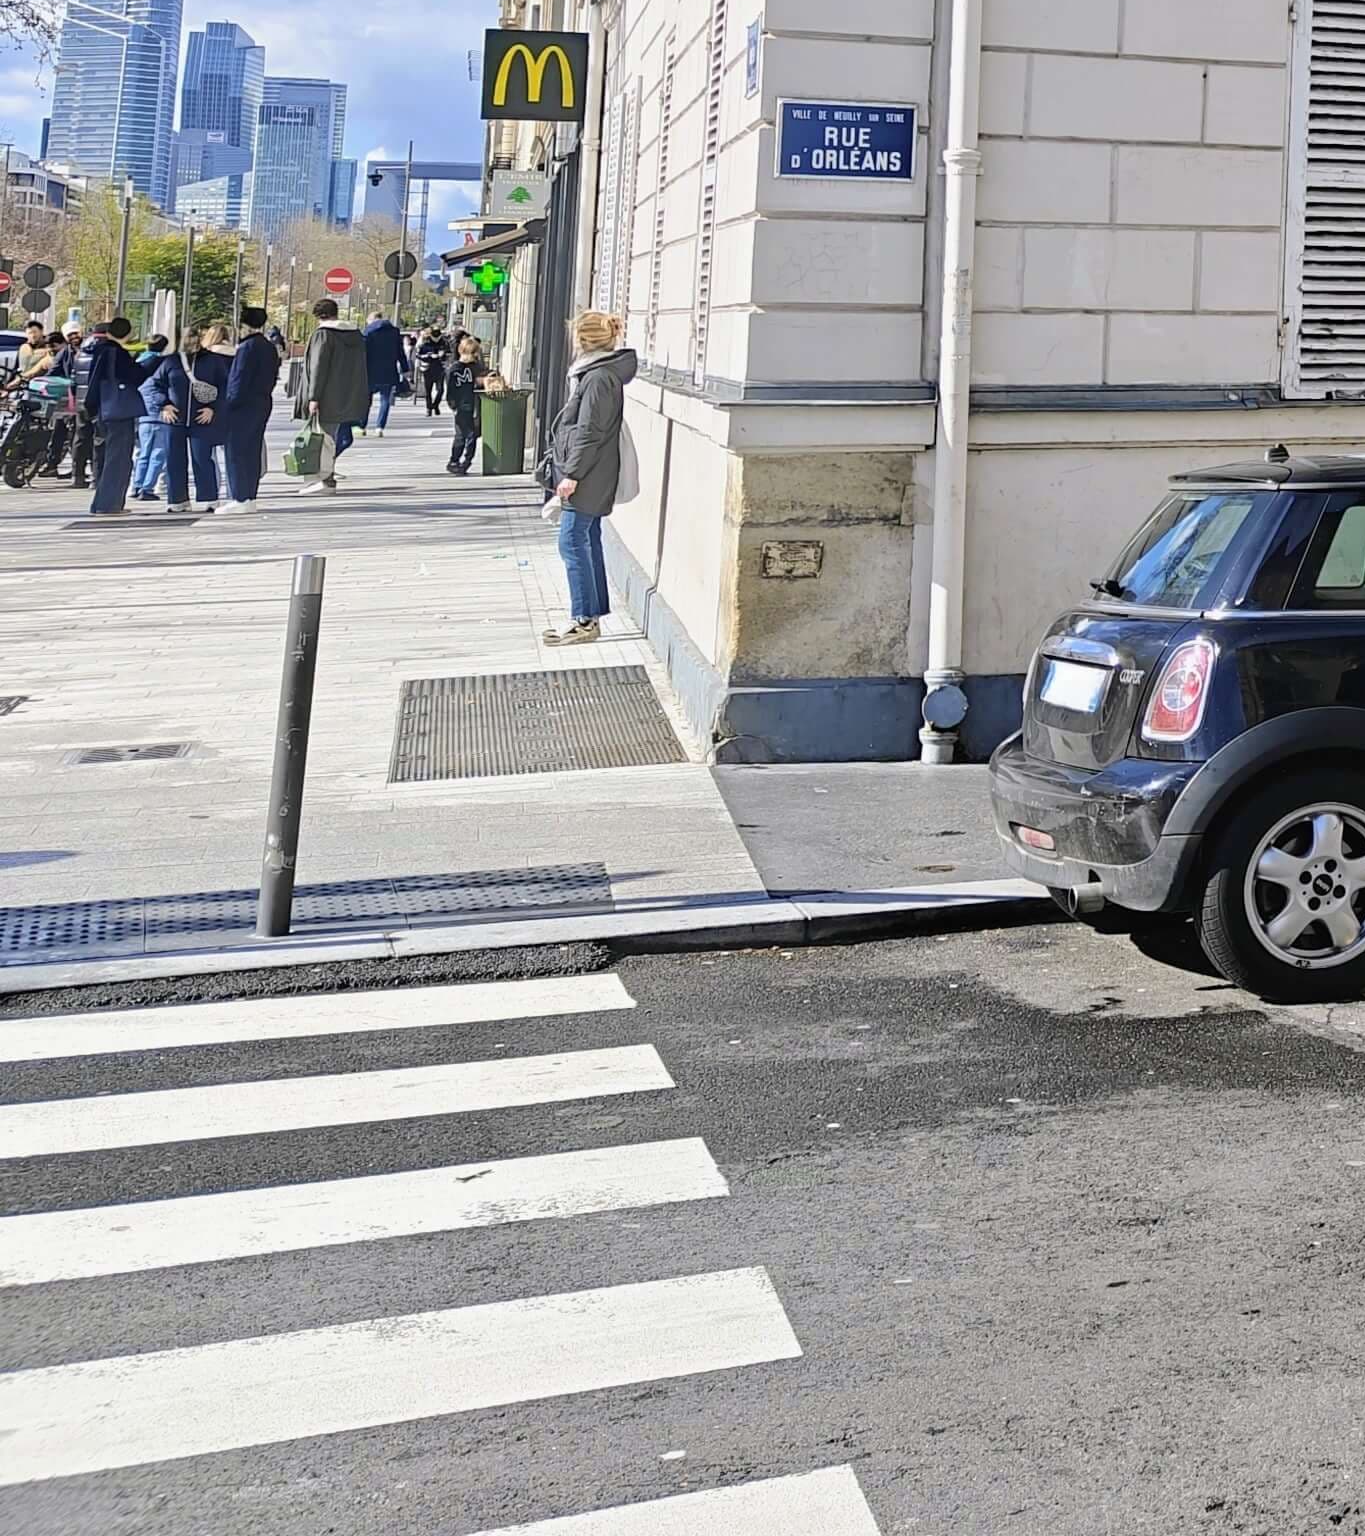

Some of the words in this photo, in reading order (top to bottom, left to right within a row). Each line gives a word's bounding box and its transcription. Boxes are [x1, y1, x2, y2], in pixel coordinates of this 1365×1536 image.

[792, 109, 811, 120] VILLE
[818, 110, 827, 121] DE
[834, 111, 861, 122] NEUILLY
[886, 112, 905, 124] SEINE
[824, 126, 871, 148] RUE
